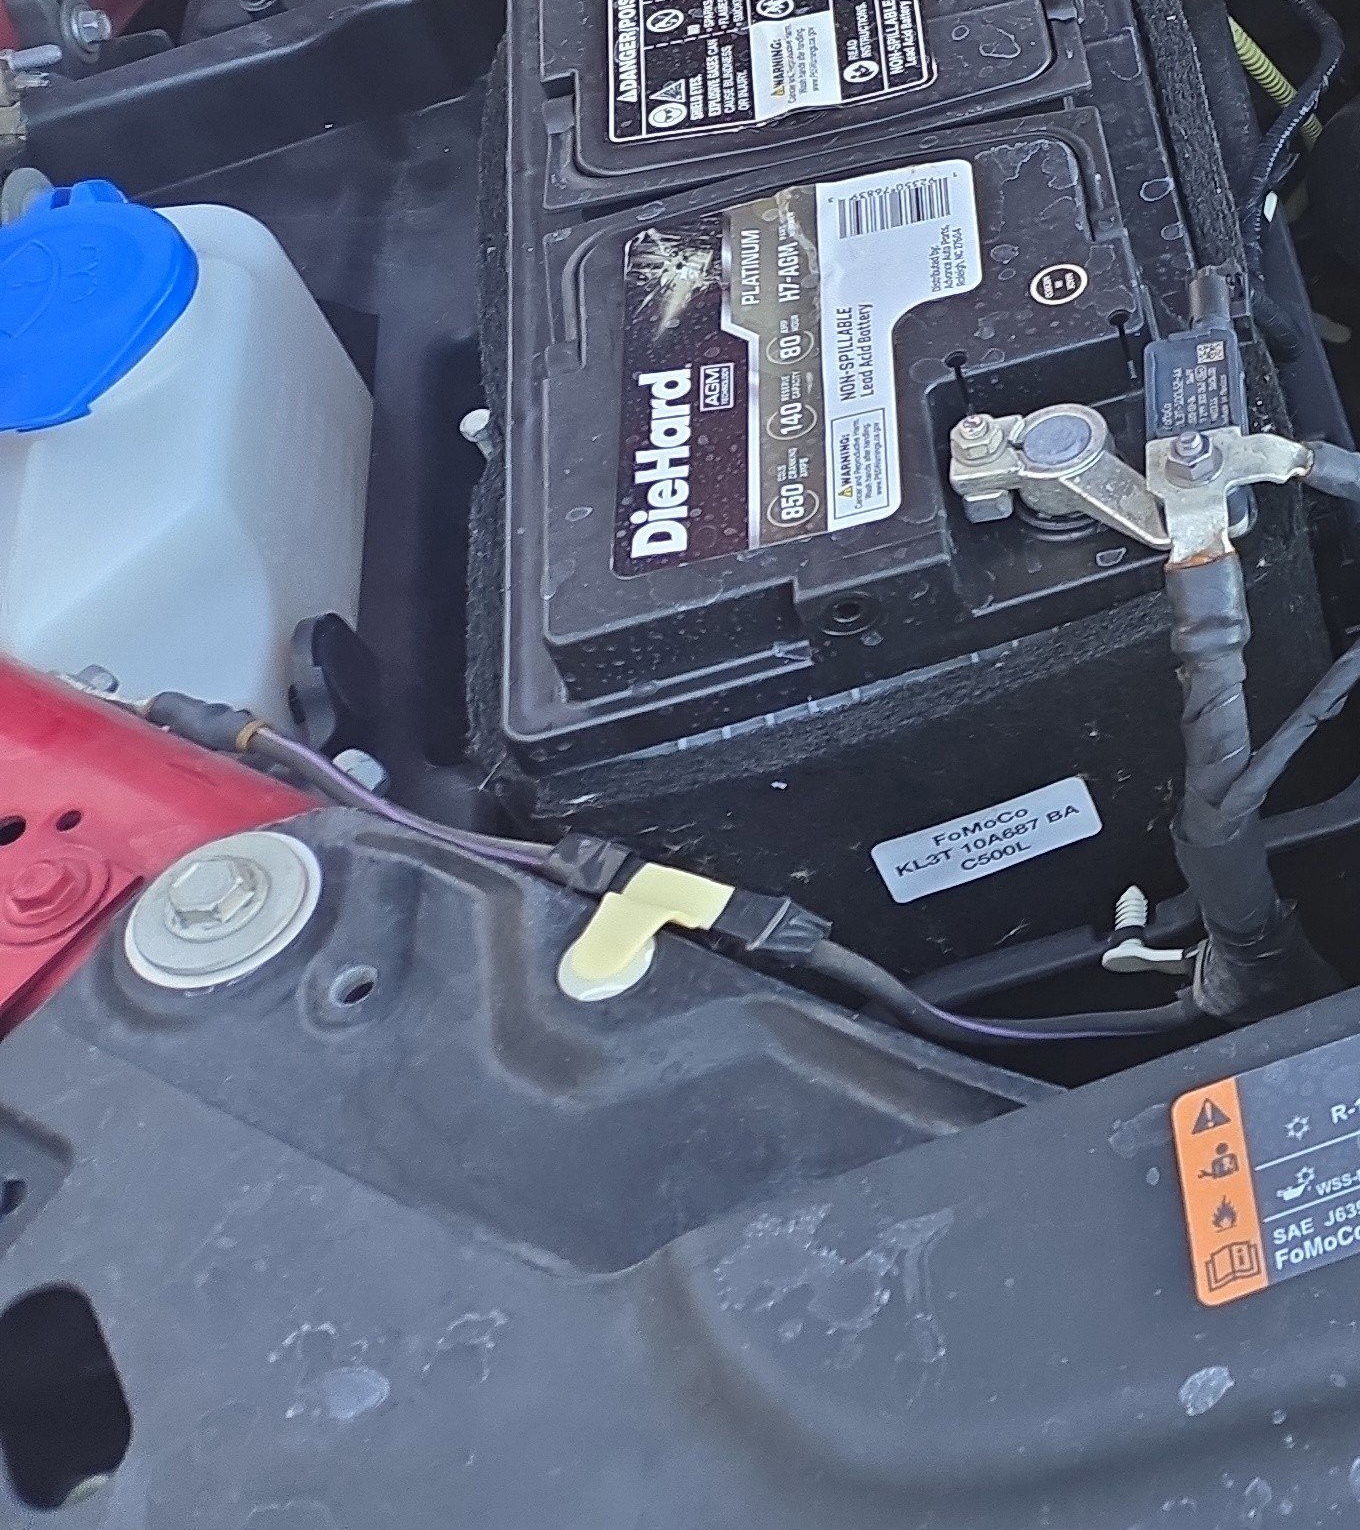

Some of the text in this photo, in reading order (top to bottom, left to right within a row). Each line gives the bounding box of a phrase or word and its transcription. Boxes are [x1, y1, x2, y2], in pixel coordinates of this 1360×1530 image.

[847, 40, 859, 61] READ
[882, 0, 903, 74] NON-SPILLABLE
[900, 1, 917, 66] Lead Acid Battery
[706, 38, 721, 116] EXPLOSIVE GASES CAN
[721, 45, 735, 113] CAUSE BLINDNESS
[770, 39, 784, 88] WARNING:
[737, 100, 749, 110] OR
[741, 230, 760, 305] PLATINUM
[778, 242, 800, 302] H7-AGM
[941, 246, 952, 261] Auto
[943, 262, 954, 289] Advance
[778, 335, 801, 359] 80
[836, 307, 856, 402] NON-SPILLABLE
[857, 304, 874, 397] Lead Acid Battery
[704, 367, 720, 405] AGM
[792, 371, 801, 399] CAPACITY
[780, 402, 802, 434] 140
[630, 368, 691, 558] DieHard
[840, 434, 851, 486] WARNING:
[781, 484, 805, 520] 850
[895, 805, 1080, 877] KL3T 10A687 BA
[932, 808, 1029, 847] FoMoCo
[960, 840, 1031, 871] C500L
[1273, 1218, 1315, 1245] SAE
